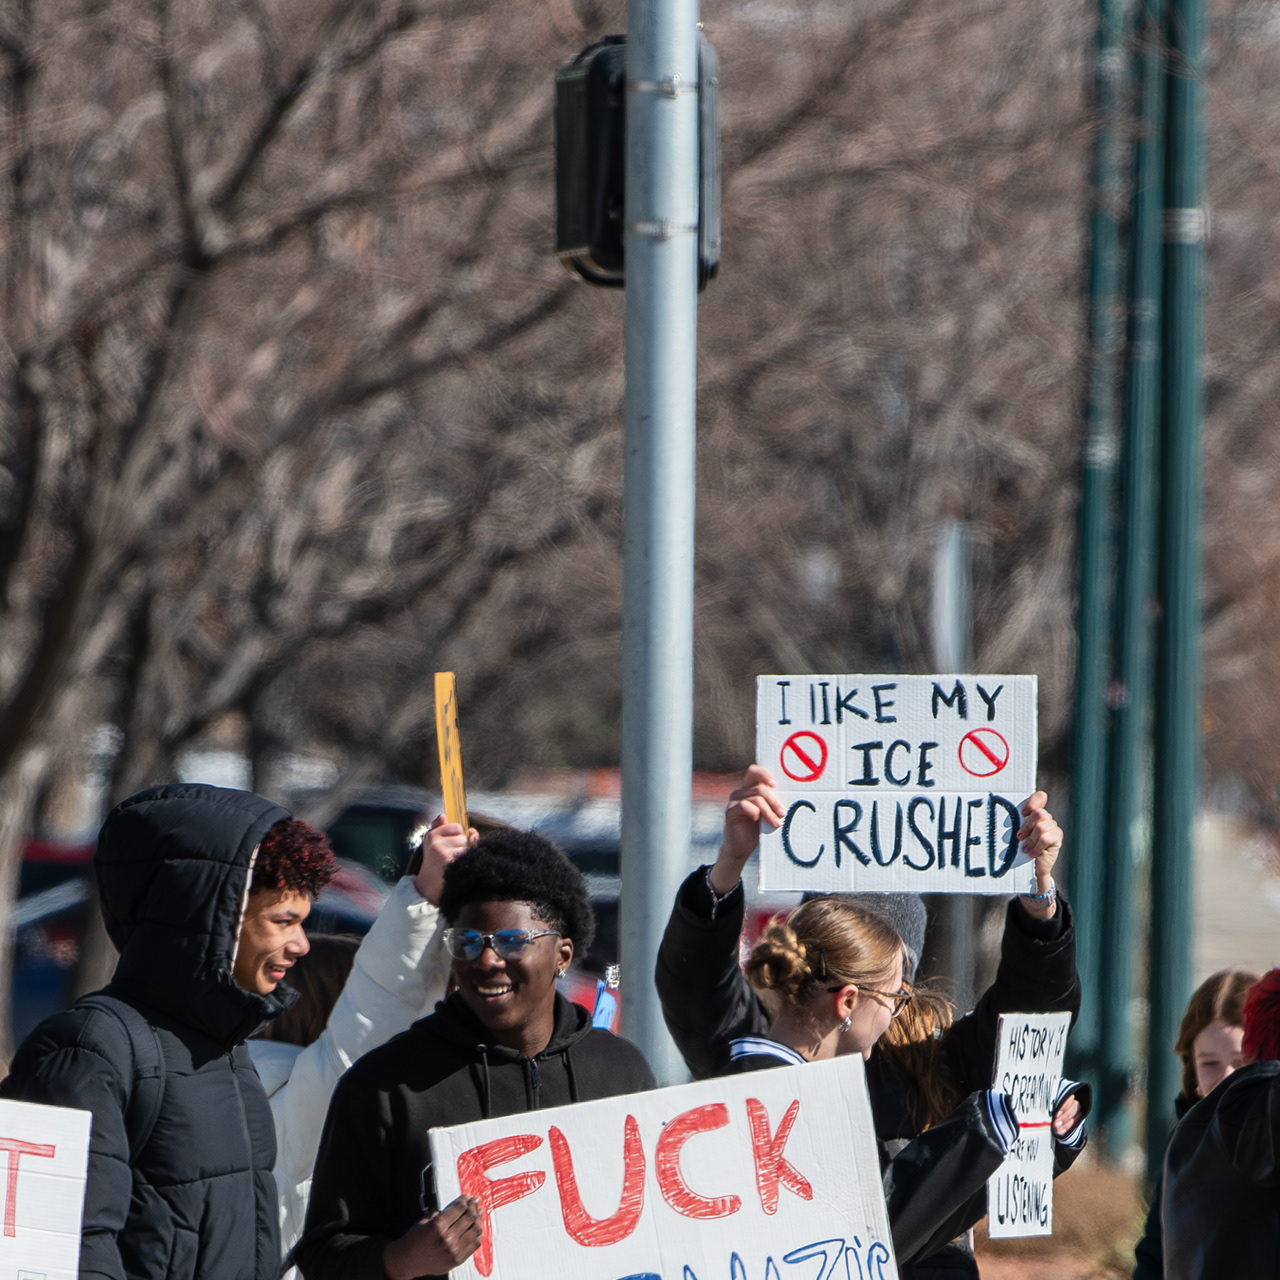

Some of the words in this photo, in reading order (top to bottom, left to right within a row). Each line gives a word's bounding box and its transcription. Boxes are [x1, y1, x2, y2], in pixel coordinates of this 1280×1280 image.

[776, 680, 792, 725] I
[931, 679, 1004, 721] MY
[848, 739, 940, 788] ICE
[781, 792, 1021, 879] CRUSHED
[1009, 1024, 1055, 1066] HISTORY
[1002, 1072, 1057, 1118] SCREAMING
[457, 1097, 814, 1278] FUCK
[997, 1173, 1048, 1227] LISTENING
